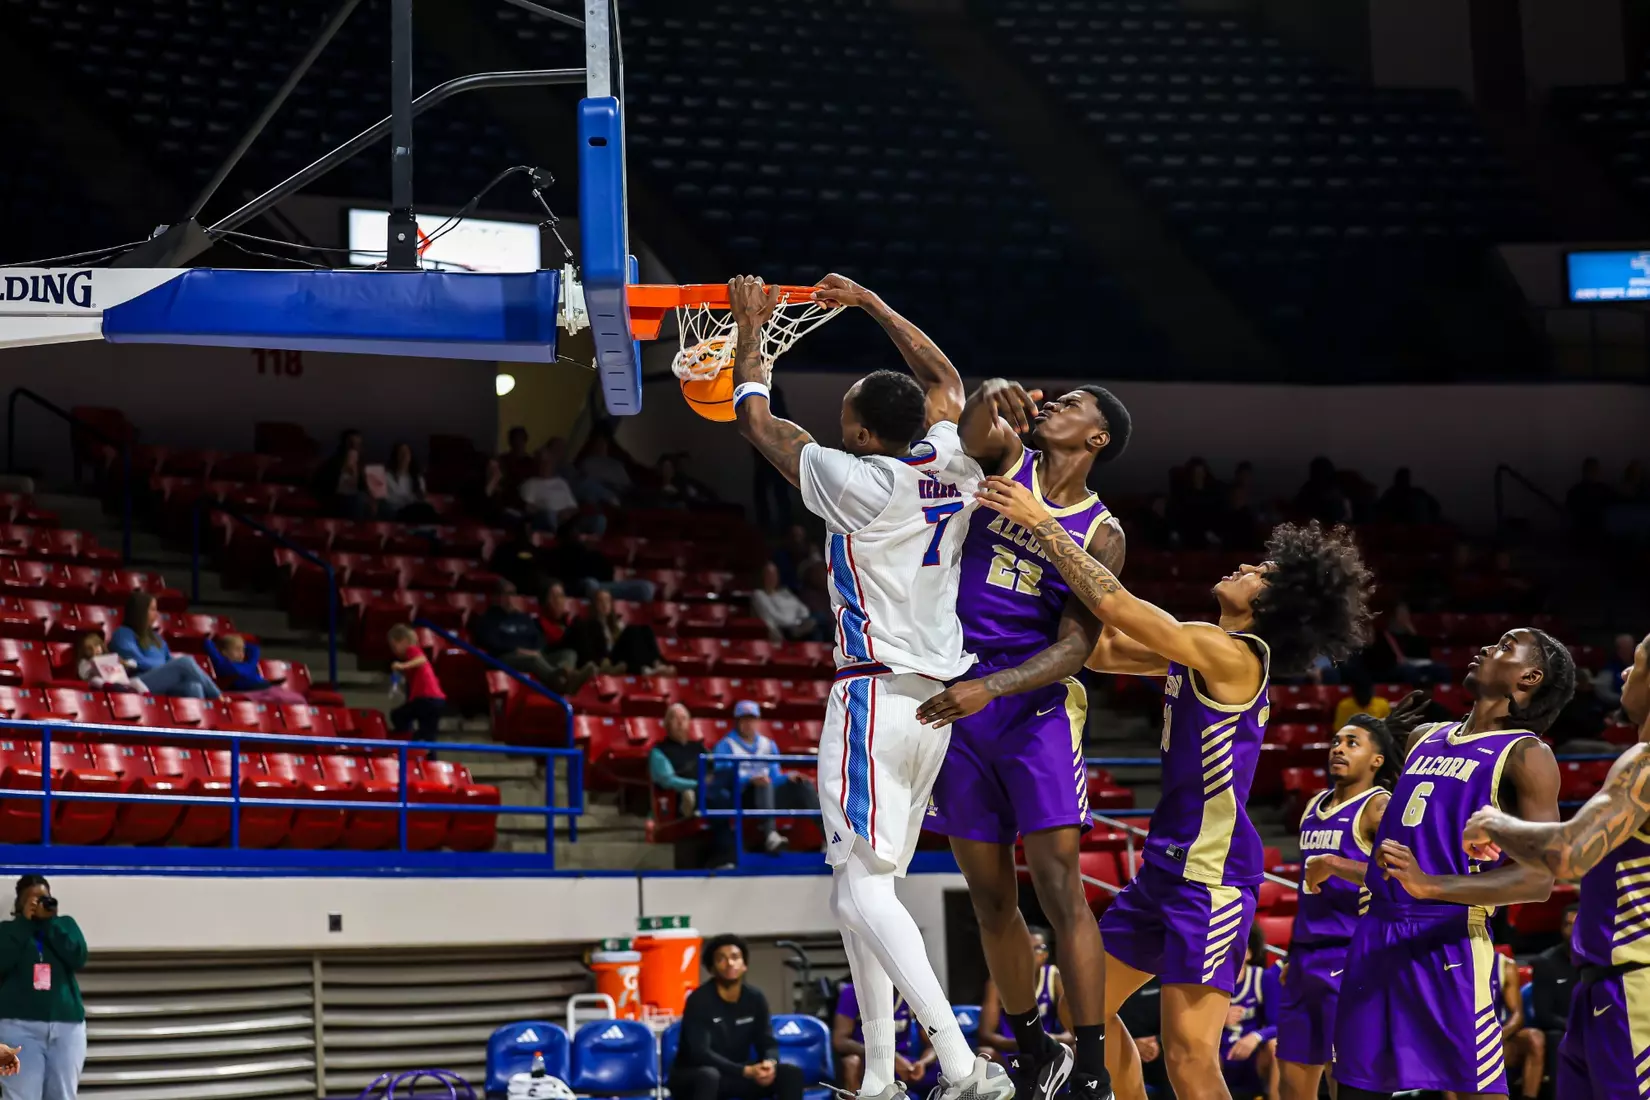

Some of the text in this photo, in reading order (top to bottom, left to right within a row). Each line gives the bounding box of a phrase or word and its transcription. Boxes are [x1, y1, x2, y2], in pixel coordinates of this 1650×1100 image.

[0, 270, 92, 308] DING
[922, 501, 964, 567] 7
[986, 544, 1043, 597] 22
[1405, 755, 1480, 782] ALCORN
[1402, 781, 1434, 828] 6
